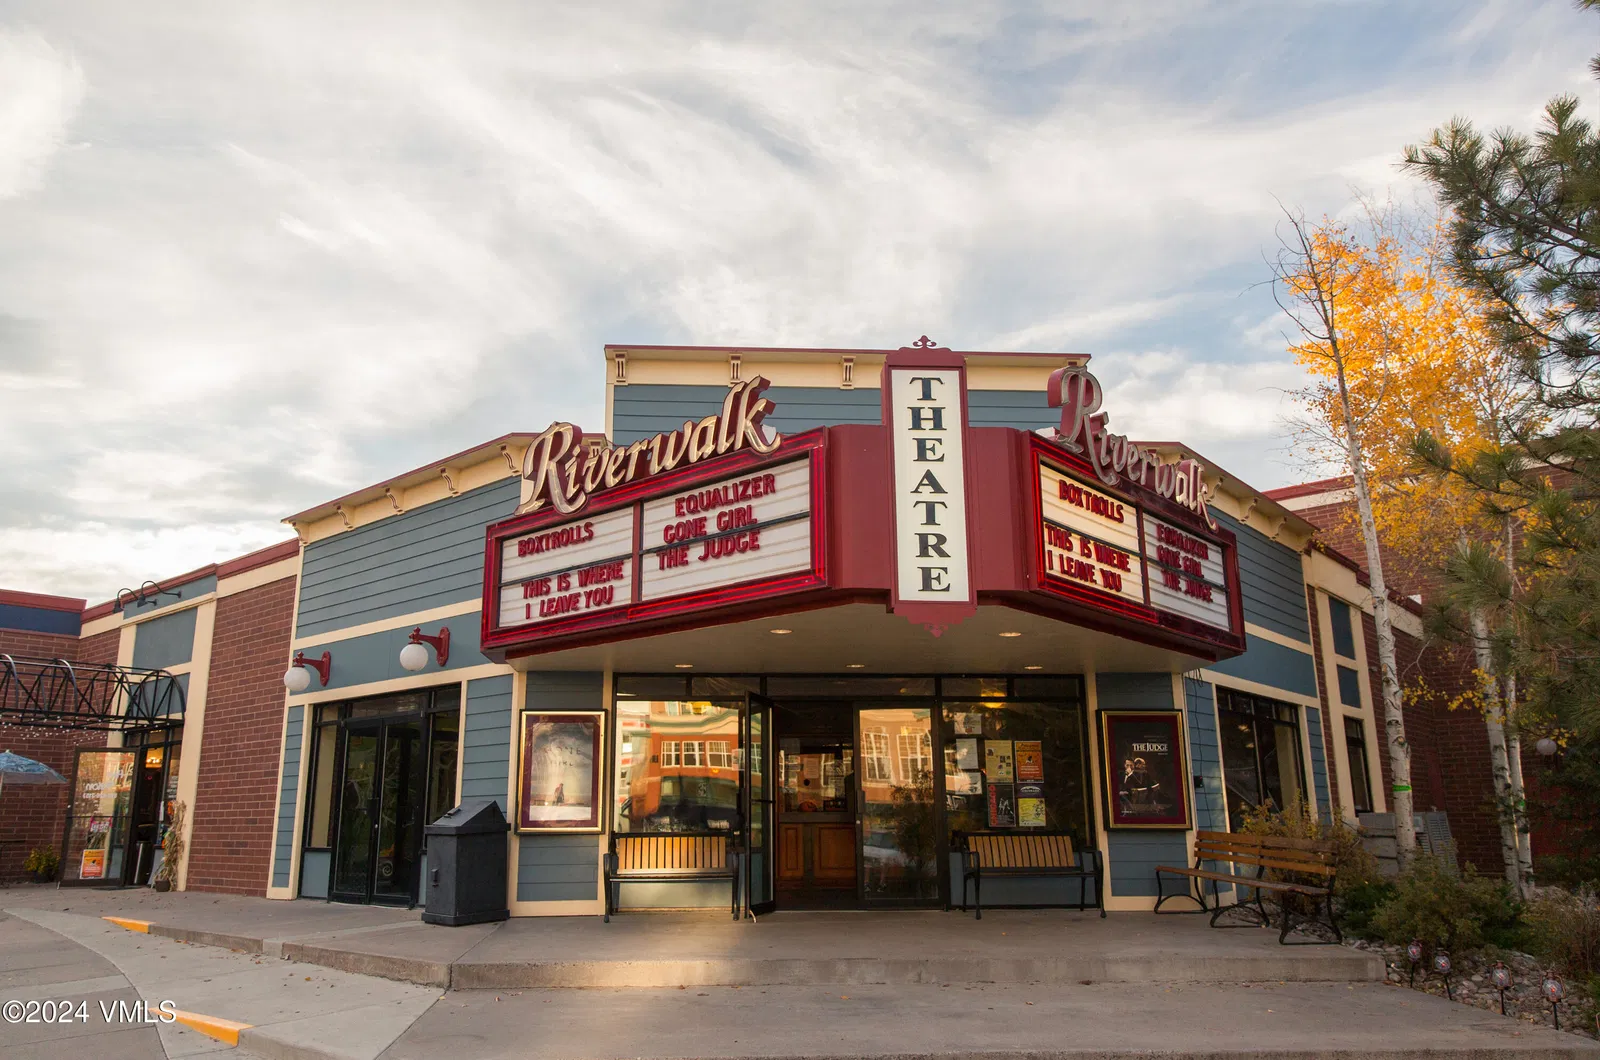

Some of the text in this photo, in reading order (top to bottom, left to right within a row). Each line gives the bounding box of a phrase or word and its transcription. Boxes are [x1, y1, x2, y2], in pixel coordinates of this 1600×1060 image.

[513, 375, 781, 517] Riverwalk
[1048, 365, 1219, 532] Riverwalk
[674, 473, 776, 518] EQUALIZER
[907, 376, 952, 593] THEATRE
[1058, 479, 1125, 524] BOXTROLLS
[517, 521, 594, 558] BOXTROLLS
[663, 504, 758, 544] GONE GIRL
[1045, 524, 1073, 553] THIS
[1080, 537, 1092, 559] IS
[656, 528, 760, 571] THE JUDGE
[1047, 549, 1123, 593] I LEAVE YOU
[521, 560, 625, 600] THIS IS WHERE
[525, 585, 614, 620] I LEAVE YOU
[1132, 742, 1169, 753] THE JUDGE
